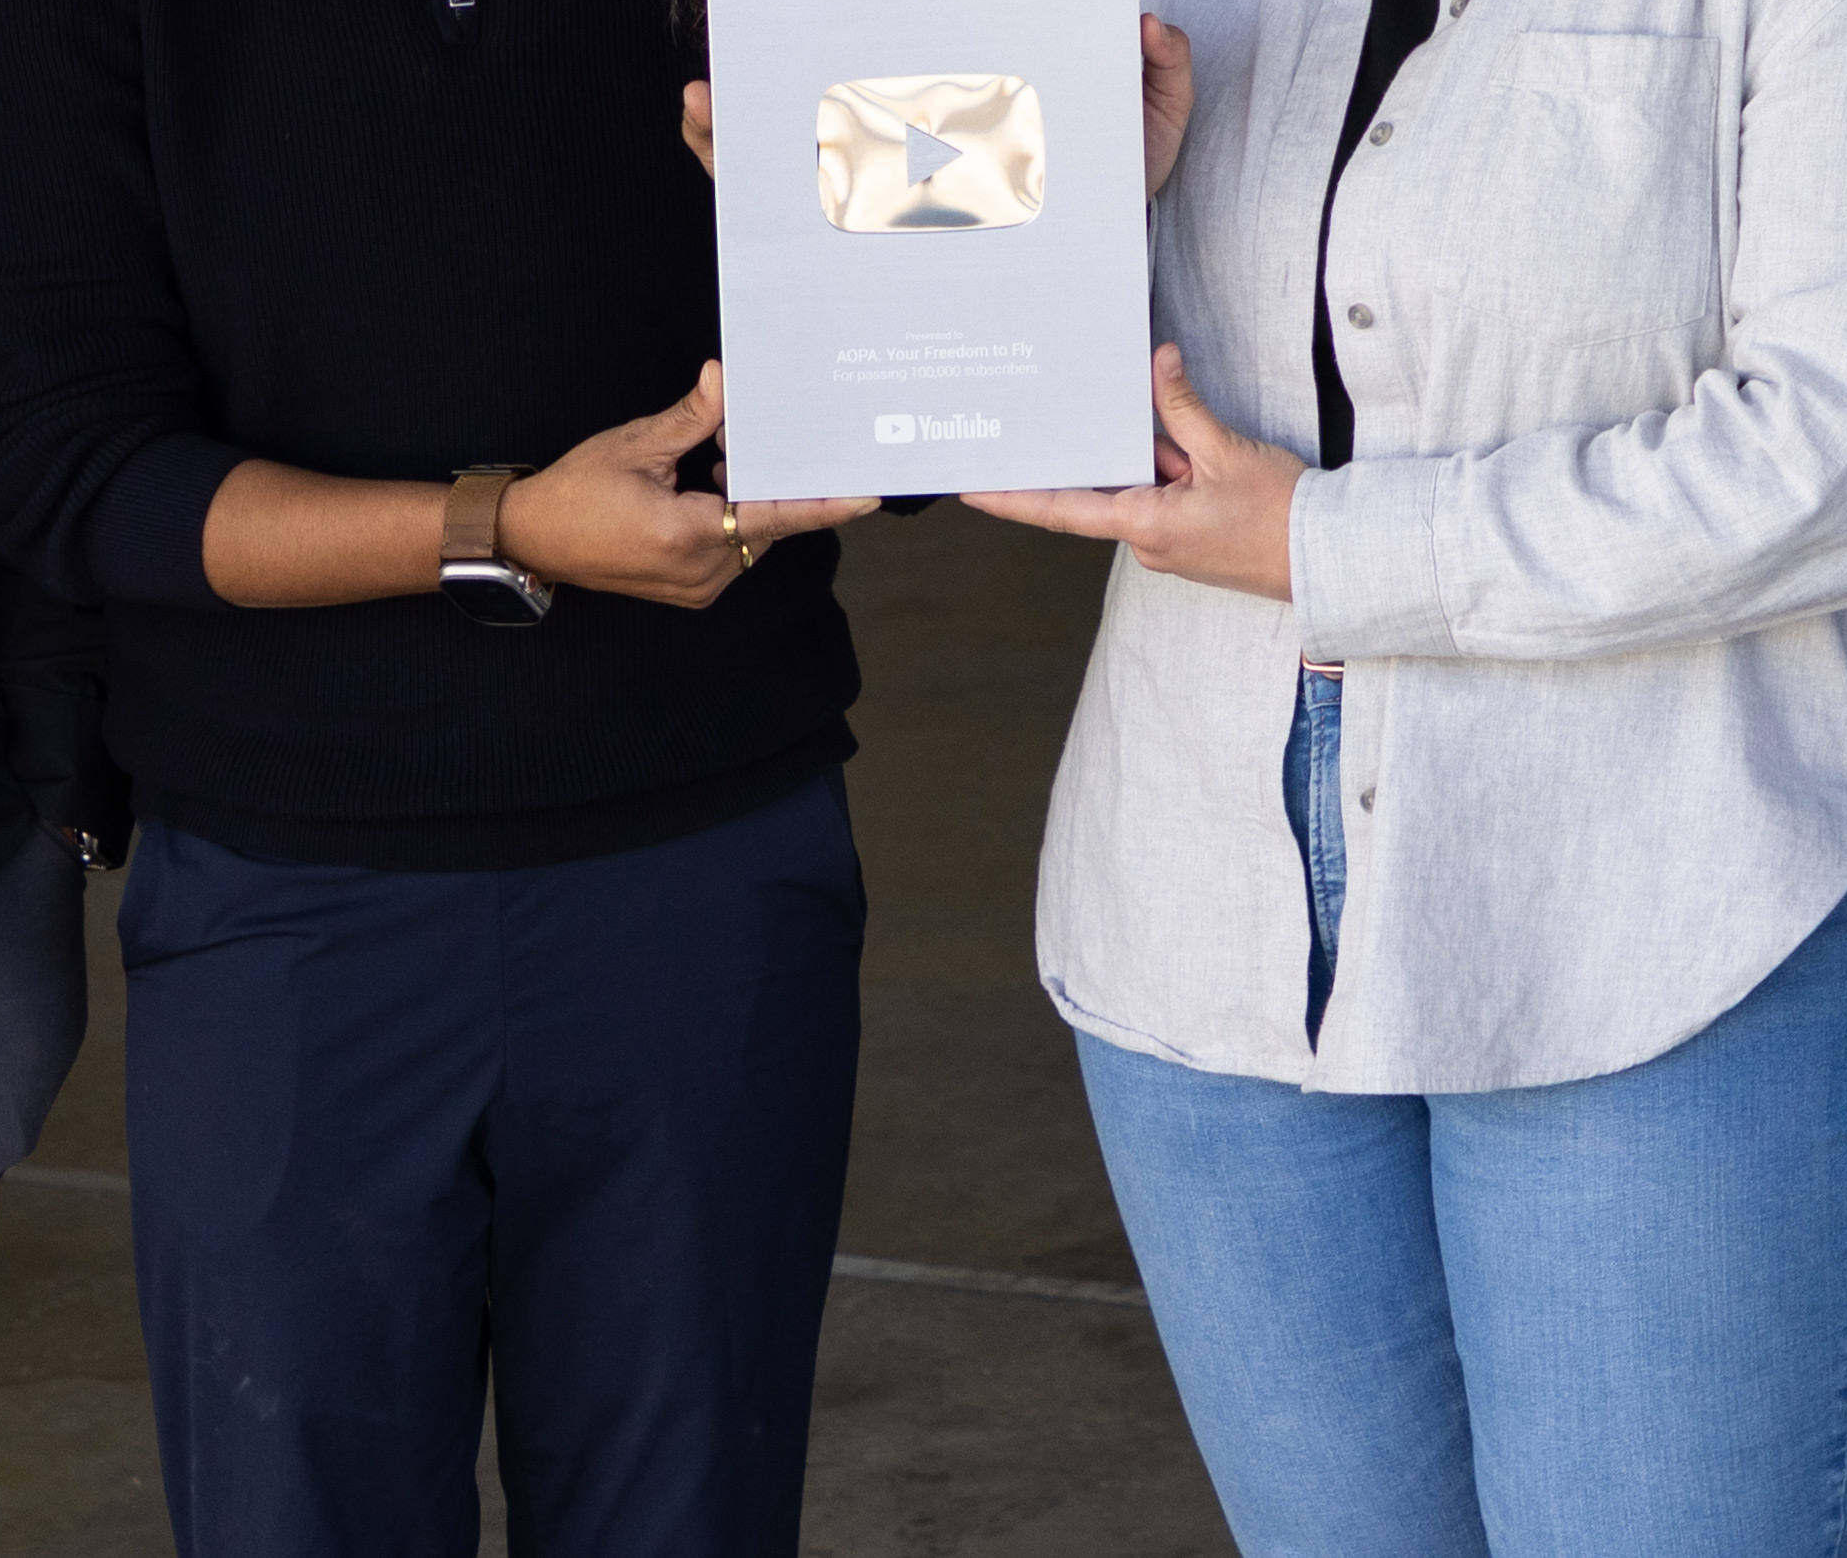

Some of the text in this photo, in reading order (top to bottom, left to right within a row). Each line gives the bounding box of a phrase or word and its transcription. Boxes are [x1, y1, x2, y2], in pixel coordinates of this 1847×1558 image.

[905, 330, 964, 342] Presented to
[836, 341, 1034, 363] AOPA: Your Freedom to Fly
[833, 362, 1038, 383] For passing 100,000 subscribers
[918, 412, 1002, 441] YouTube
